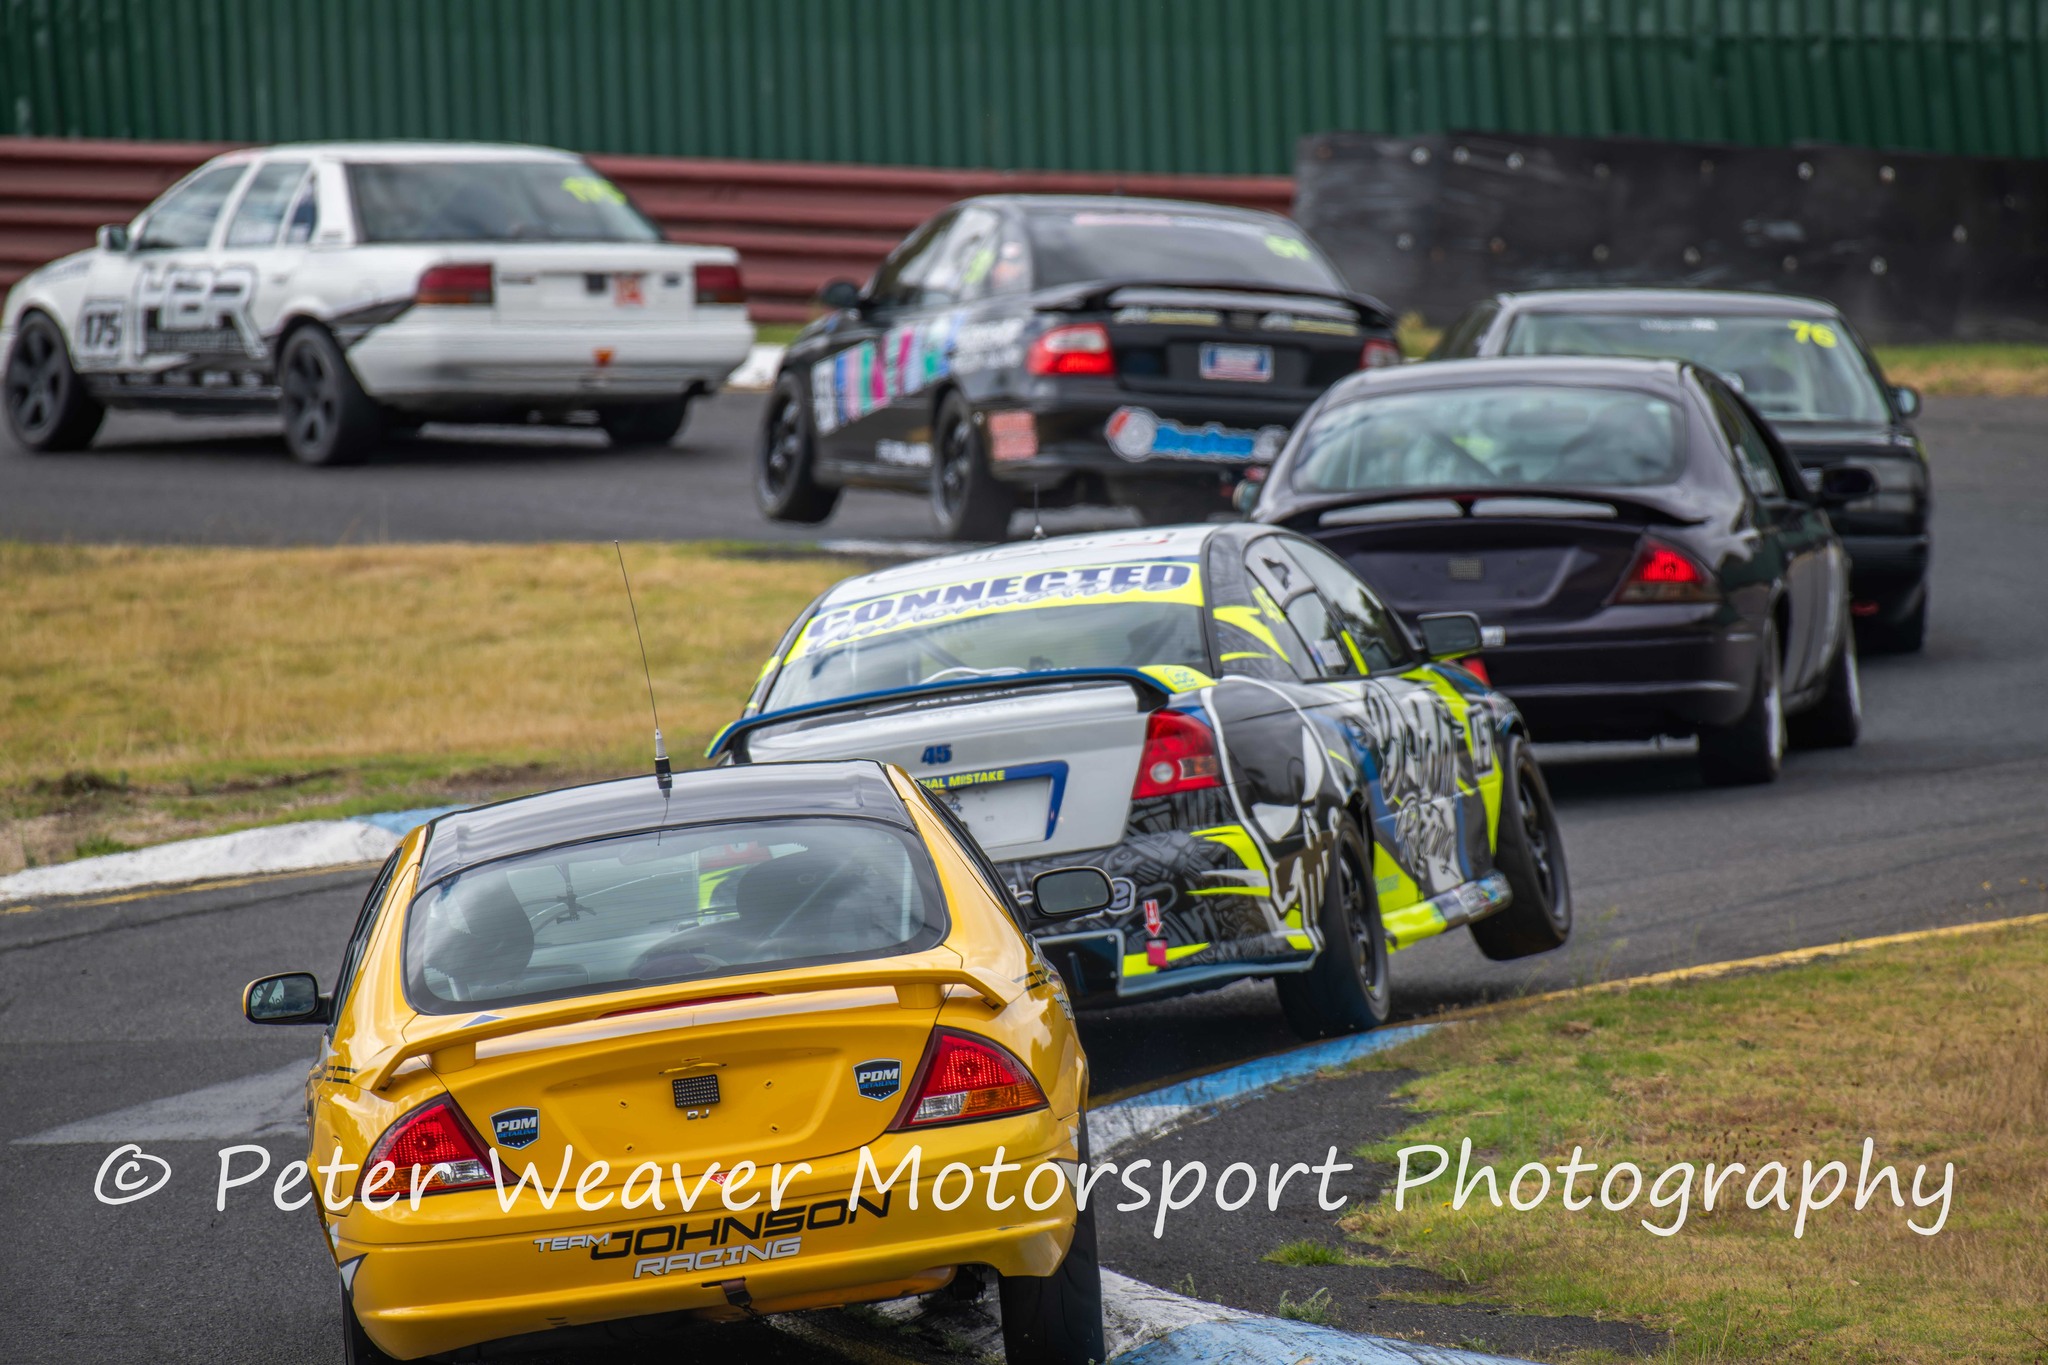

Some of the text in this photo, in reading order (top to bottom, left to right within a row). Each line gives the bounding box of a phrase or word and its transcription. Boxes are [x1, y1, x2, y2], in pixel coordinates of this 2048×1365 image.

[84, 311, 123, 349] 175
[1787, 319, 1837, 348] 76
[805, 564, 1192, 640] CONNECTED
[921, 744, 953, 765] 45
[948, 770, 1005, 788] MISTAKE
[858, 1068, 899, 1084] PDM
[859, 1080, 898, 1090] DETAILING
[496, 1116, 537, 1133] PDM
[497, 1128, 537, 1139] DETAILING
[533, 1190, 892, 1261] TEAM JOHNSON
[633, 1236, 802, 1279] RACING
